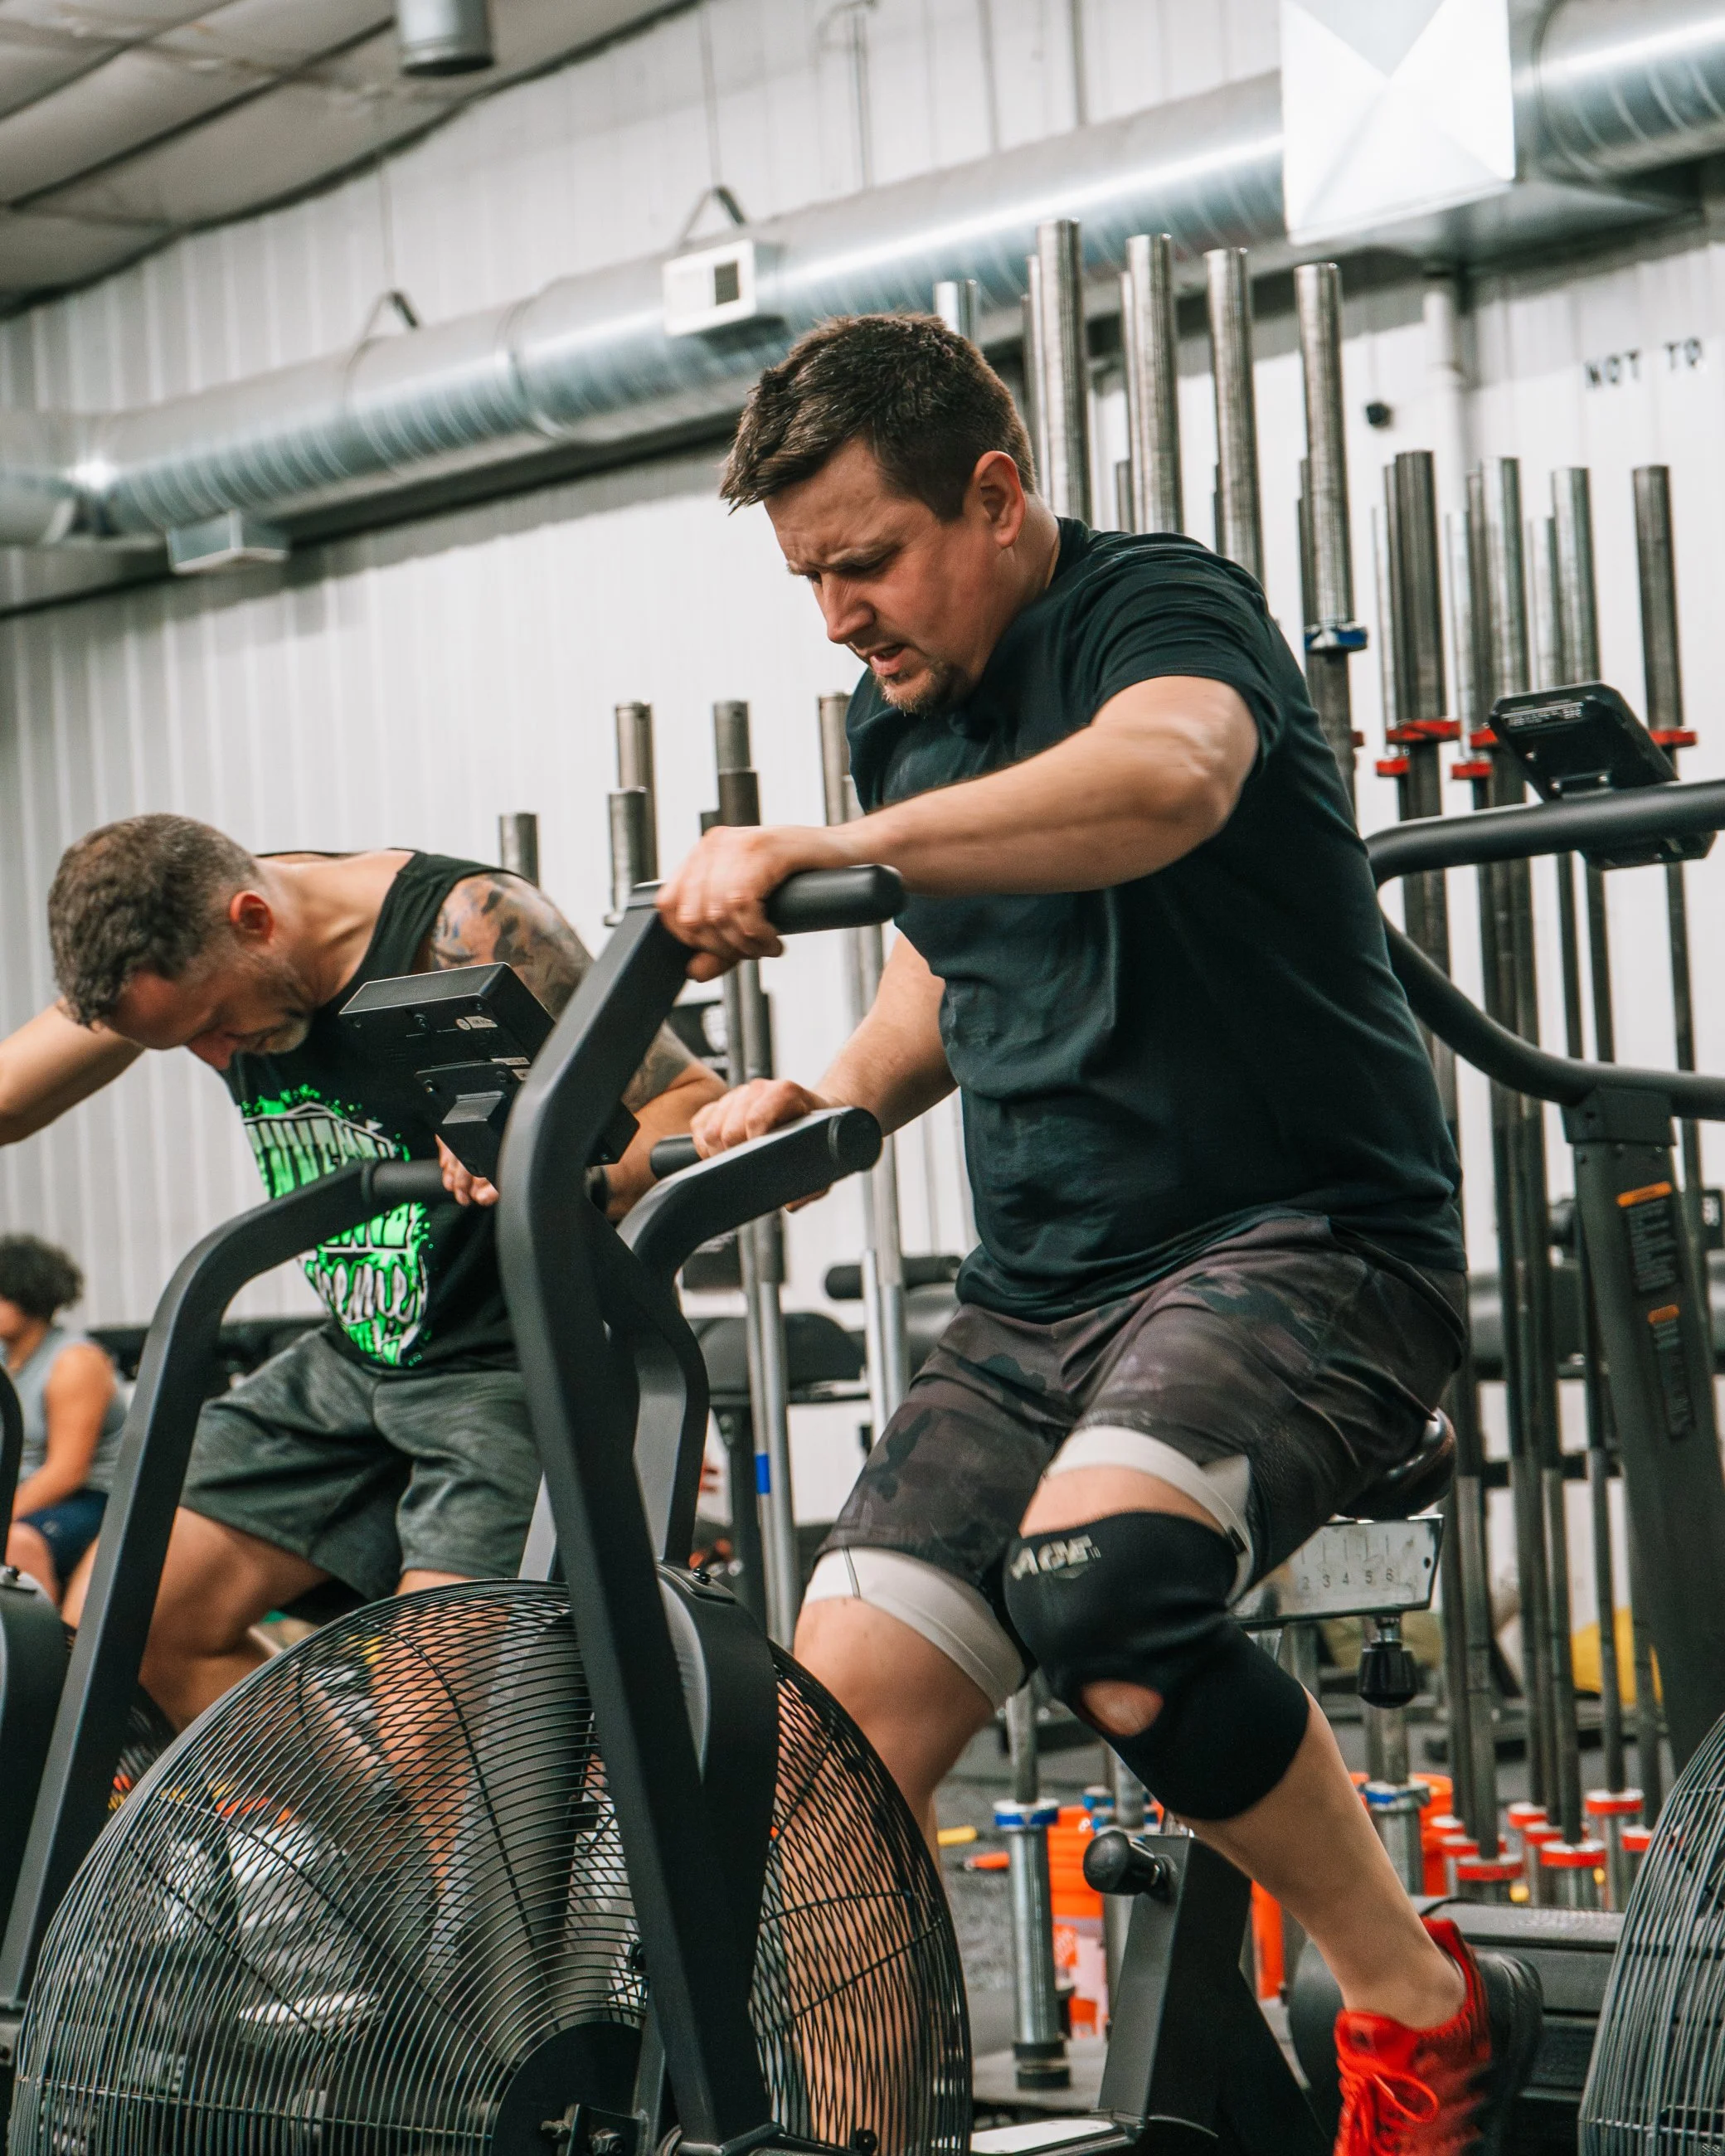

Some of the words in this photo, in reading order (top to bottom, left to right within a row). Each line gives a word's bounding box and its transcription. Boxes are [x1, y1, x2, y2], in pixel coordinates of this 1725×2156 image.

[1584, 347, 1641, 389] NOT
[1663, 337, 1703, 371] TO
[1322, 1574, 1330, 1589] 3
[1342, 1571, 1349, 1585] 4
[1365, 1569, 1373, 1584] 5
[1386, 1567, 1393, 1582] 6
